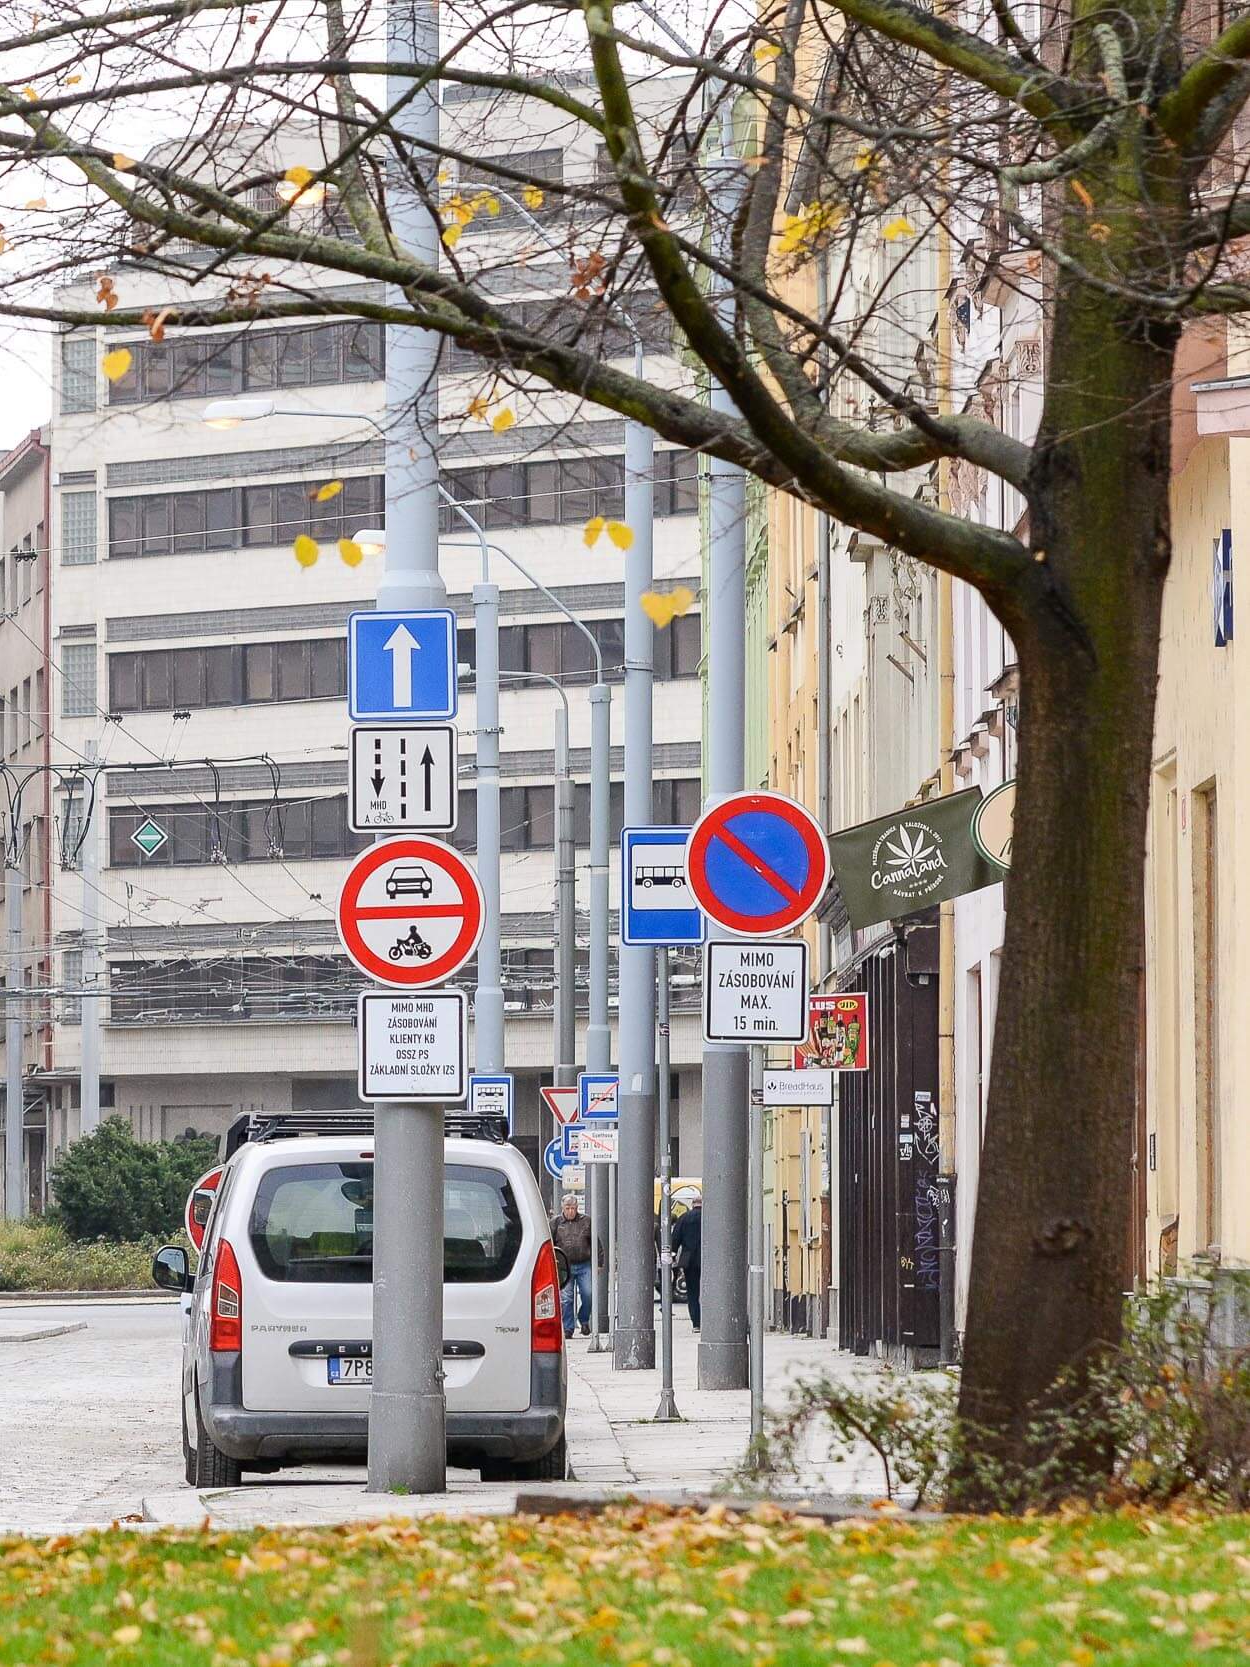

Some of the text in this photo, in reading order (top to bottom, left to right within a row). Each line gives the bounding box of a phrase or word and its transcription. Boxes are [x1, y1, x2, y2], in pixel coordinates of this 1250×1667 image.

[370, 800, 387, 810] MHD
[364, 814, 371, 824] A
[740, 952, 774, 967] MIMO
[719, 969, 795, 989] ZÁSOBOVÁNÍ
[391, 1002, 434, 1013] MIMO MHD
[740, 995, 772, 1010] MAX.
[388, 1017, 437, 1029] ZÁSOBOVÁNÍ
[733, 1015, 779, 1031] 15 min.
[389, 1034, 435, 1044] KLIENTY KB
[396, 1050, 429, 1060] OSSZ PS
[370, 1062, 455, 1075] ZÁKLADNÍ SLOŽKY IZS
[780, 1081, 824, 1090] BreadHaus
